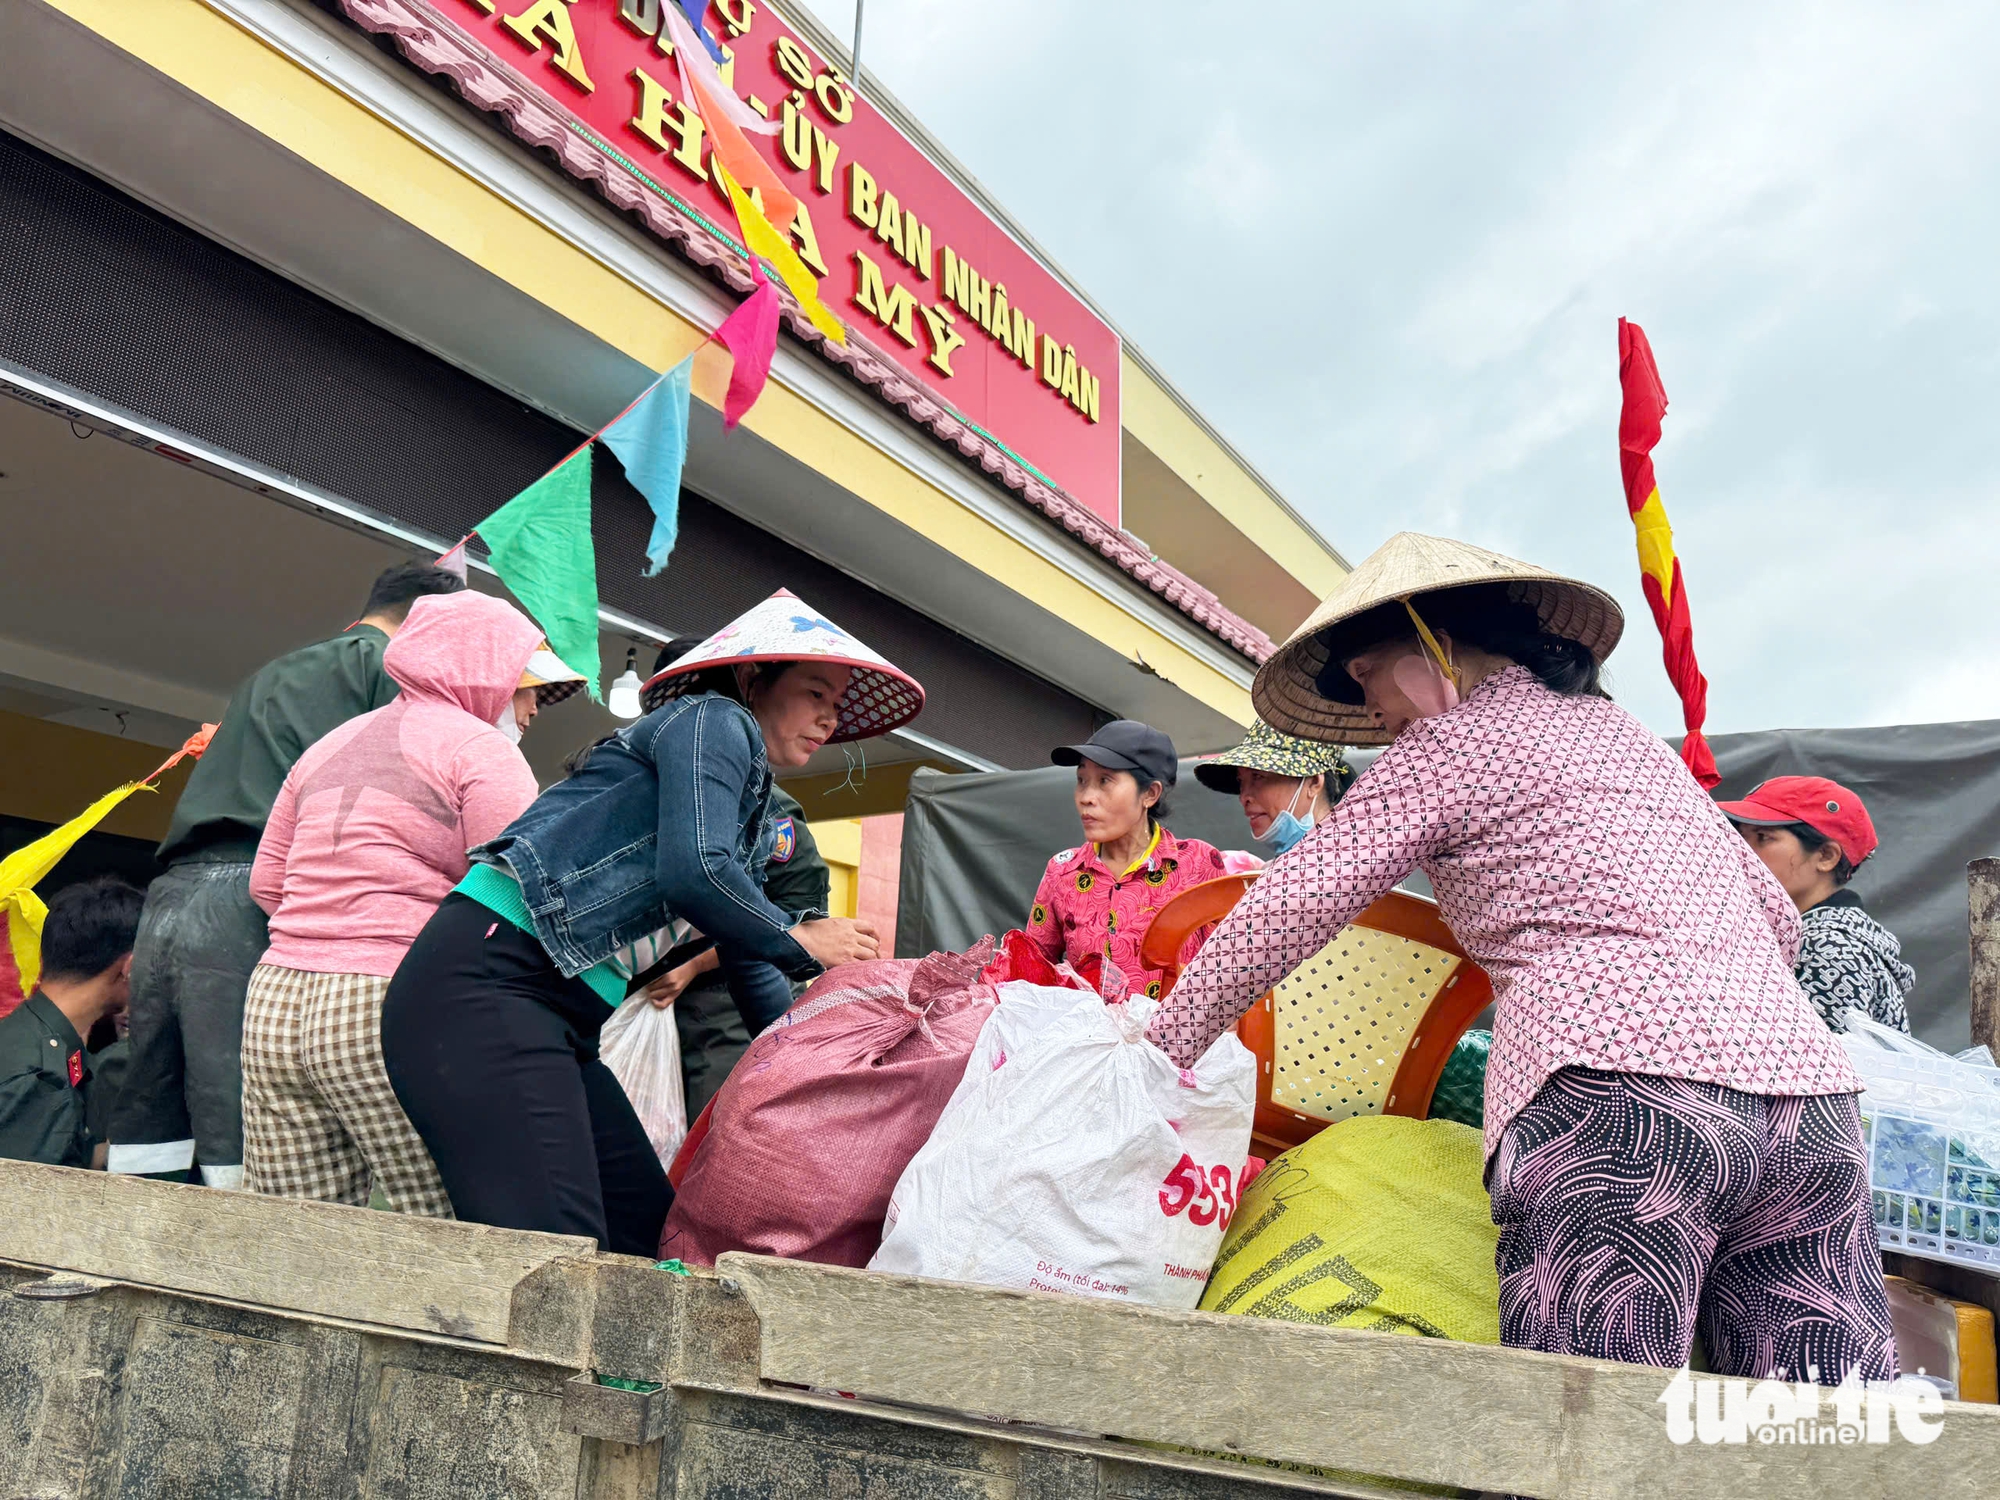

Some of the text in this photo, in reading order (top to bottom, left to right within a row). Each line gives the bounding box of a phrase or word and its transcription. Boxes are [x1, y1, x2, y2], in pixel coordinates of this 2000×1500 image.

[778, 36, 856, 124] SỞ
[631, 66, 830, 277] HA
[854, 249, 966, 378] MỸ
[782, 89, 841, 195] ỦY
[850, 160, 932, 281] BAN
[943, 244, 1035, 370] NHÂN
[1041, 332, 1100, 424] DÂN
[1158, 1152, 1247, 1232] 553
[1036, 1260, 1053, 1276] Độ
[1163, 1262, 1192, 1280] THÀNH
